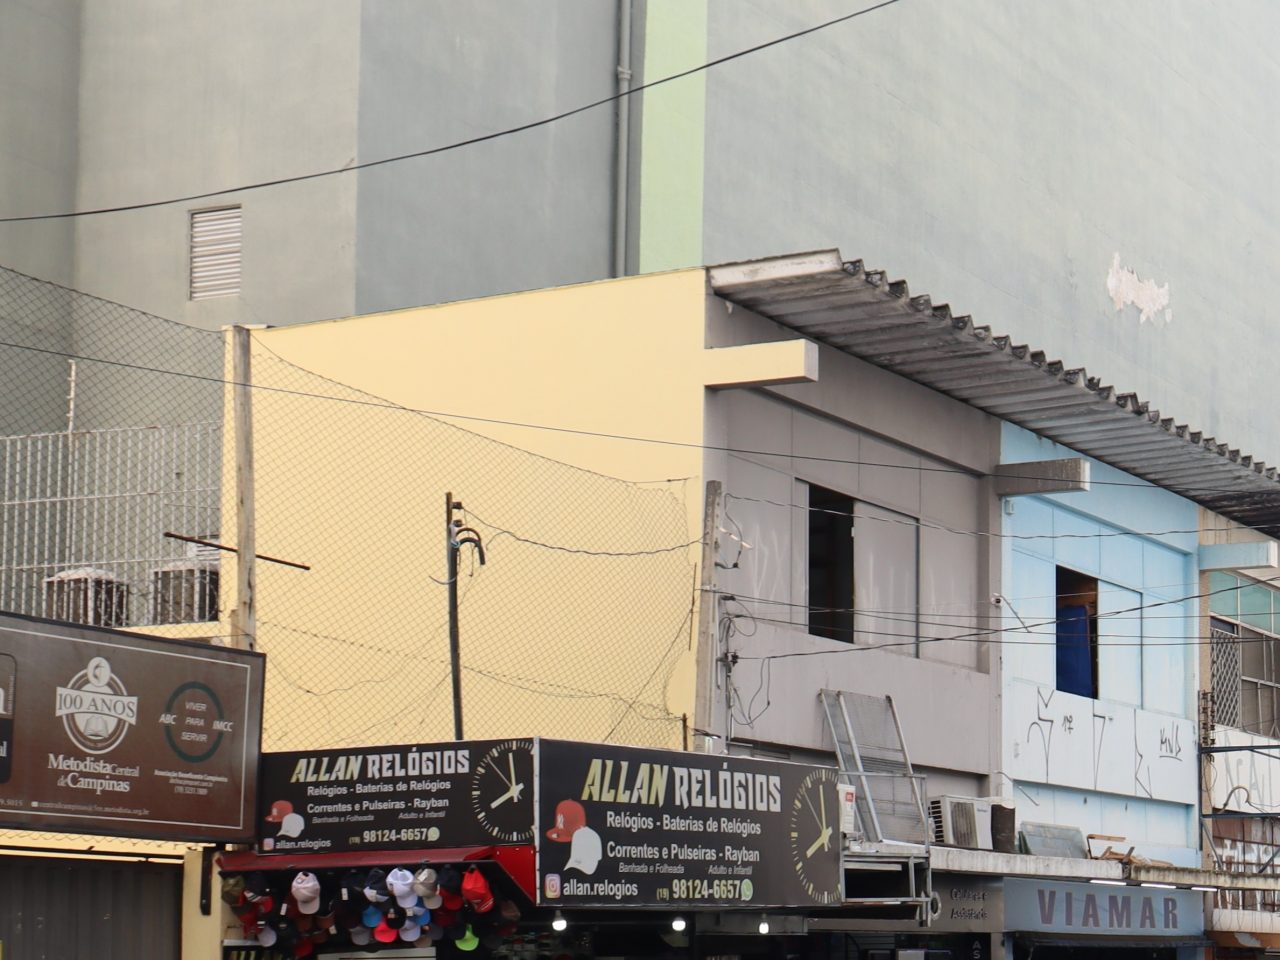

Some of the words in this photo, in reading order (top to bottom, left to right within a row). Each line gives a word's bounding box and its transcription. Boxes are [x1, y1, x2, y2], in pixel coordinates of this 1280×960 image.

[57, 693, 83, 711] 100
[86, 698, 136, 719] ANOS
[159, 713, 177, 725] ABC
[290, 755, 363, 783] ALLAN
[366, 747, 470, 780] RELÓGIOS
[307, 785, 348, 798] Relógios
[356, 781, 394, 794] Baterias
[396, 781, 408, 792] de
[410, 780, 451, 793] Relógios
[581, 758, 669, 808] ALLAN
[672, 762, 781, 812] RELÓGIOS
[307, 802, 352, 814] Correntes
[354, 803, 360, 812] e
[362, 799, 405, 811] Pulseiras
[413, 798, 449, 811] Rayban
[607, 811, 654, 833] Relógios
[663, 814, 704, 832] Baterias
[706, 816, 718, 833] de
[720, 818, 761, 838] Relógios
[276, 838, 331, 850] allan.relogios
[363, 828, 427, 843] 98124-6657
[607, 841, 659, 859] Correntes
[661, 847, 668, 859] e
[671, 844, 717, 861] Pulseiras
[725, 846, 760, 865] Rayban
[619, 862, 648, 874] Banhada
[649, 865, 655, 874] e
[655, 863, 685, 875] Folheada
[708, 865, 726, 875] Adulto
[734, 865, 753, 876] Infantil
[563, 880, 638, 900] allan.relogios
[672, 879, 741, 899] 98124-6657
[1038, 889, 1178, 929] VIAMAR
